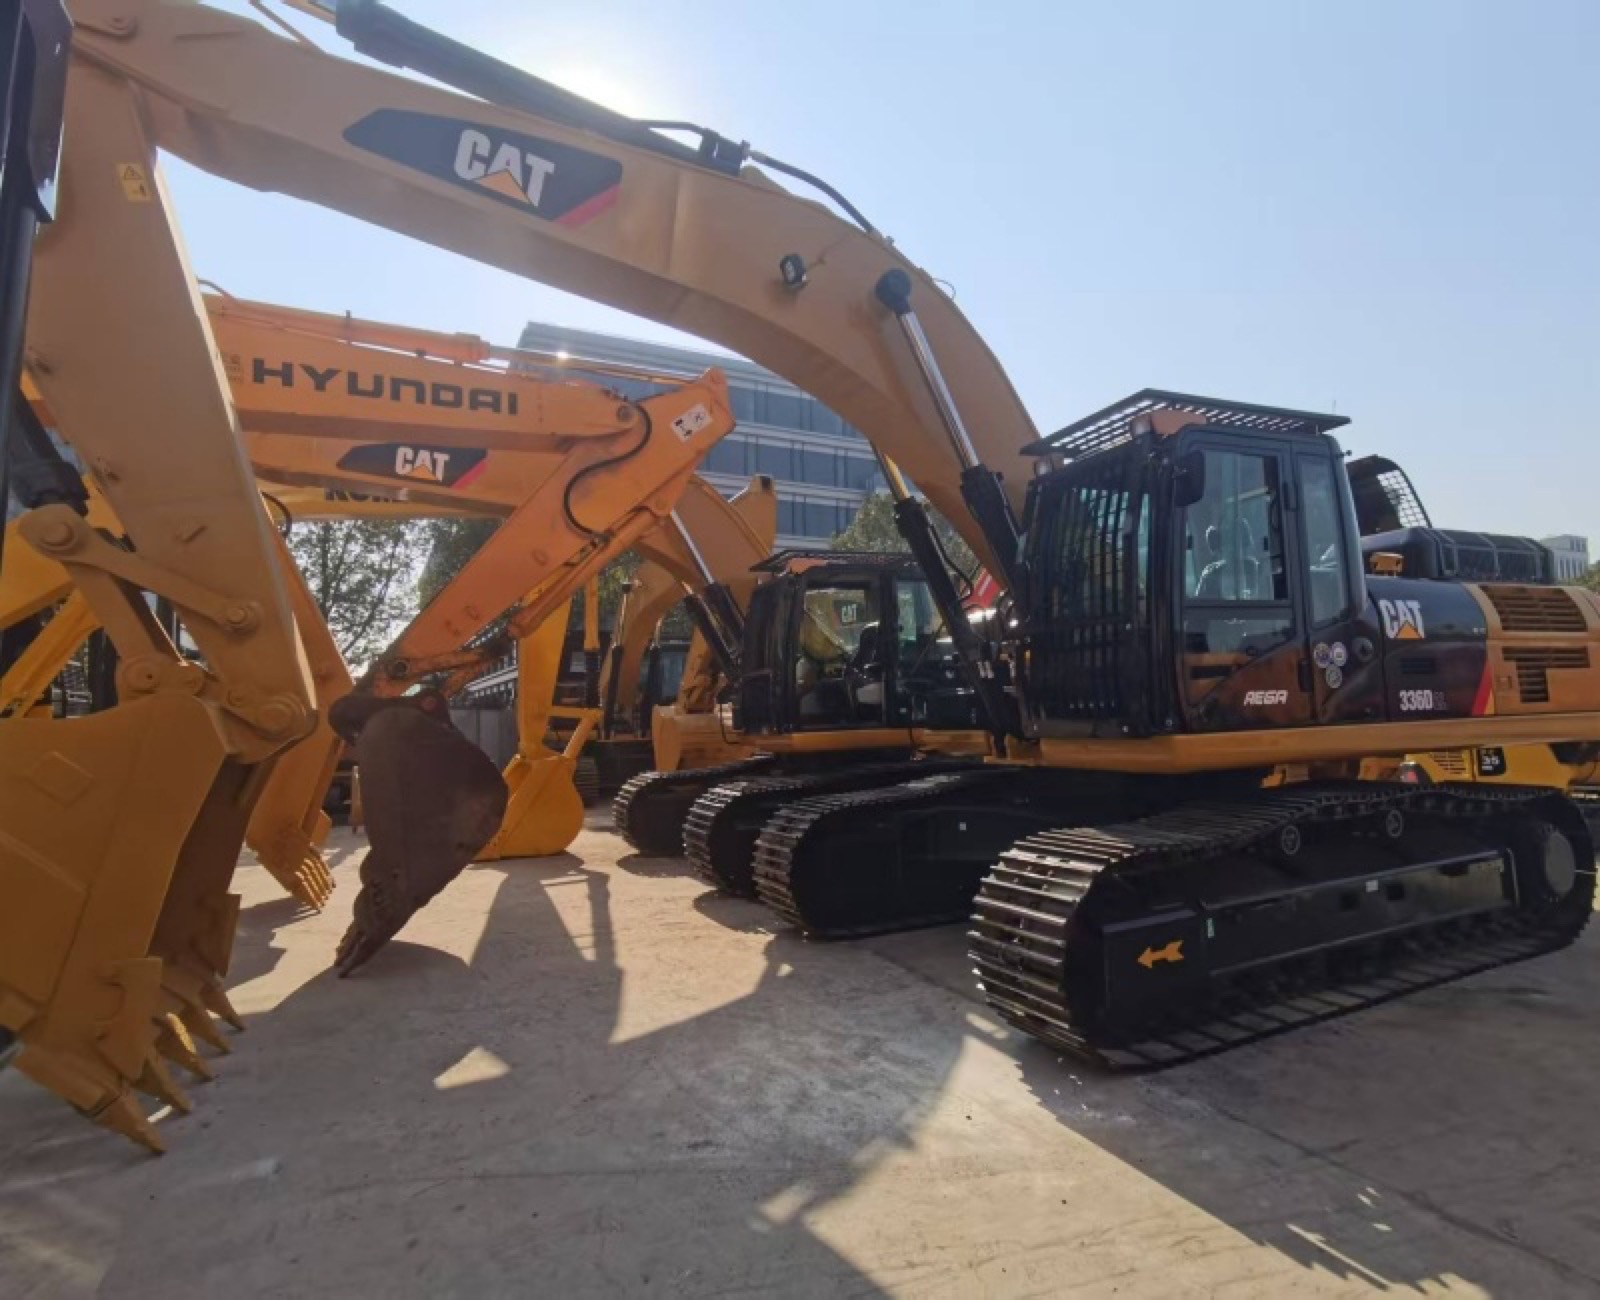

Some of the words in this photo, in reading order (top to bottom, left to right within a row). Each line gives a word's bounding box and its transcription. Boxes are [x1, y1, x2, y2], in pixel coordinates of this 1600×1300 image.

[454, 129, 555, 208] CAT
[252, 357, 518, 416] HYUNDAI
[395, 446, 449, 482] CAT
[1379, 599, 1425, 639] CAT
